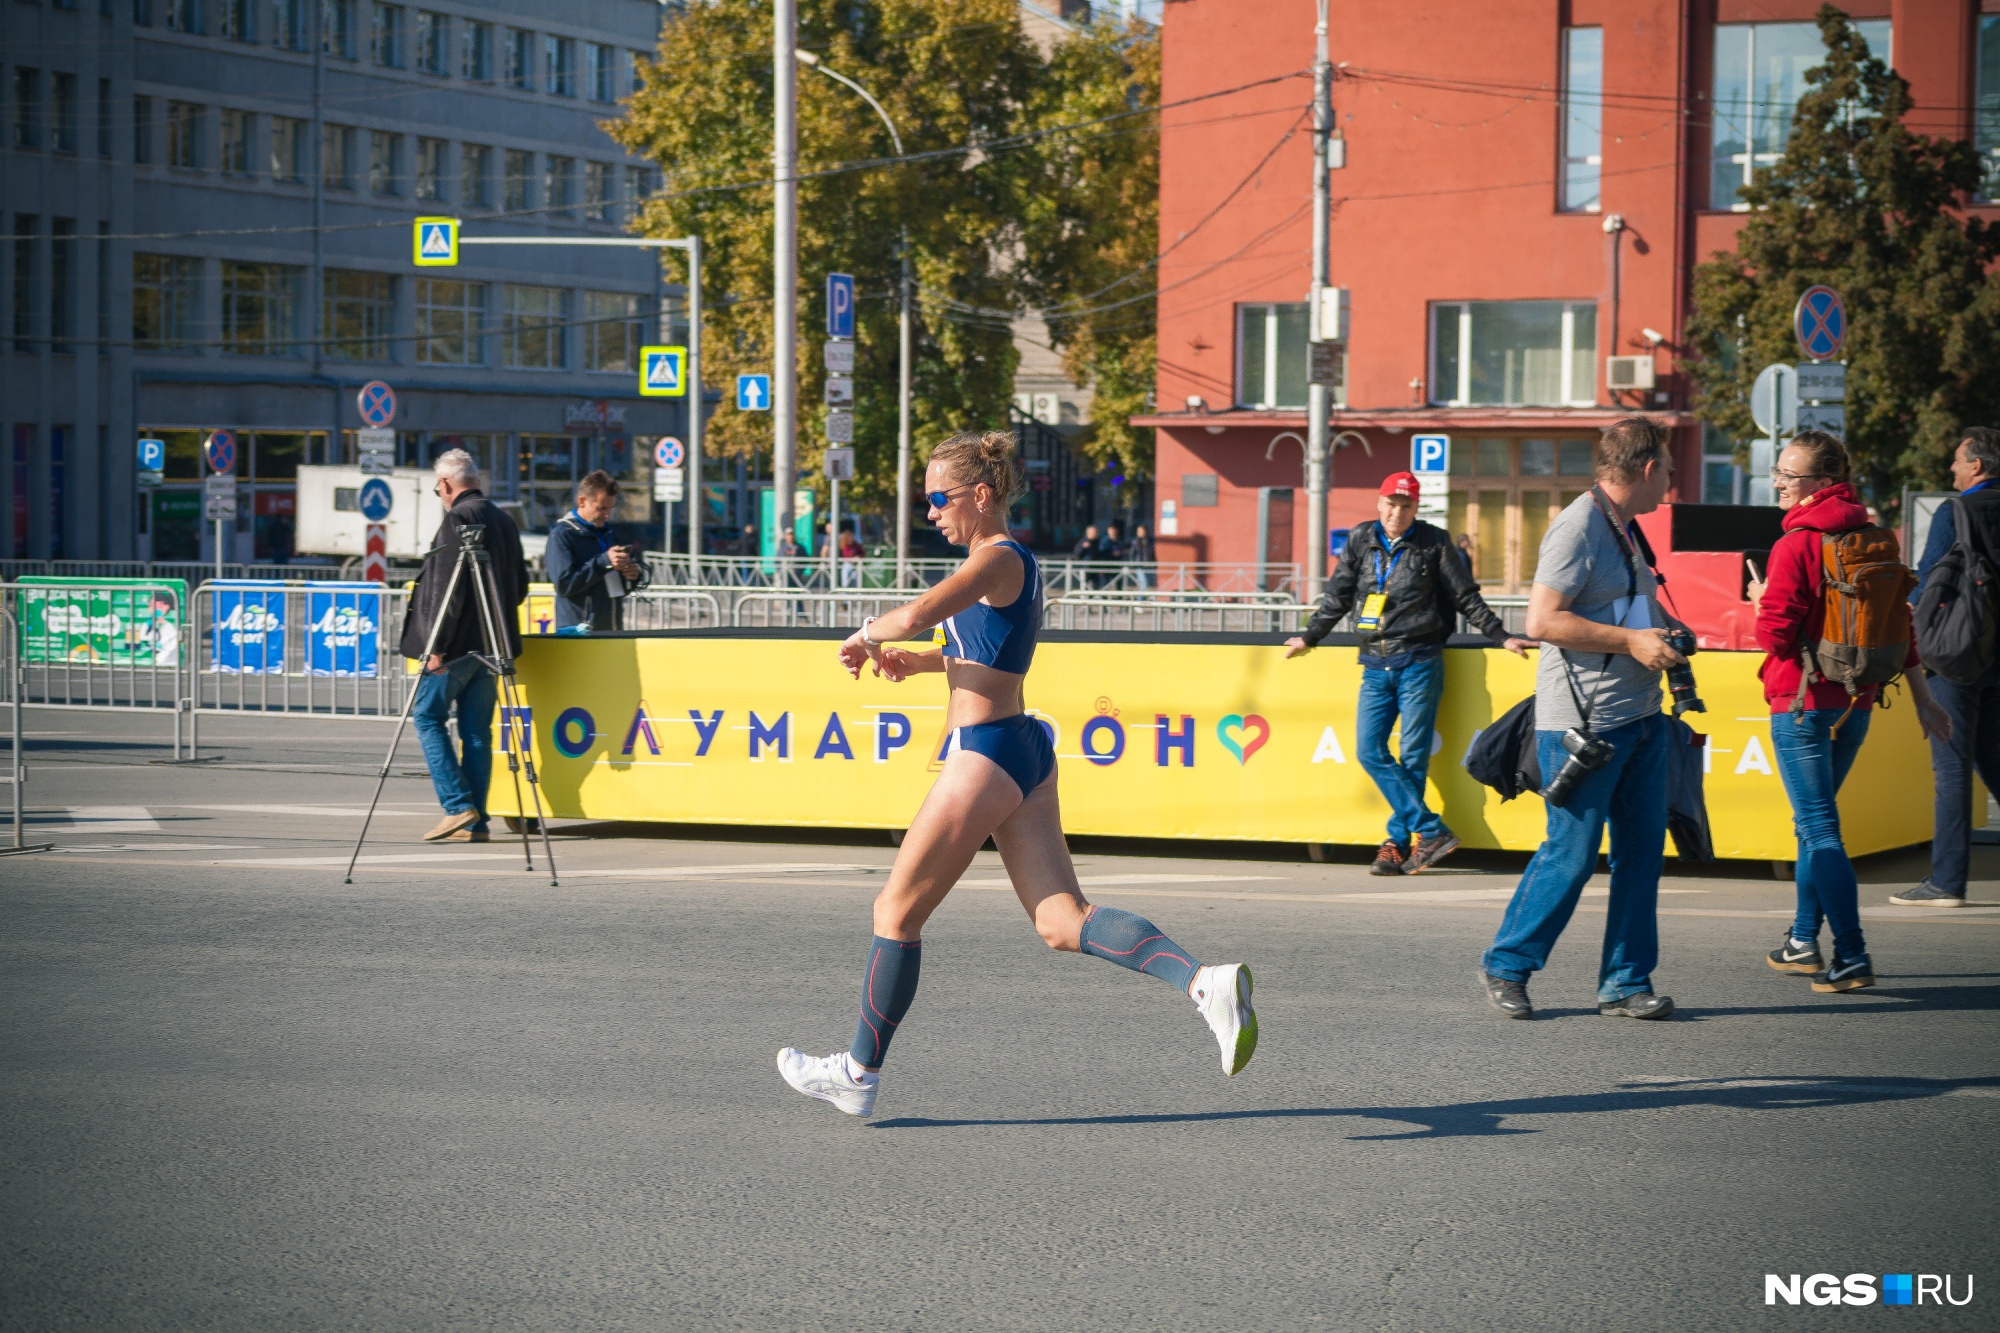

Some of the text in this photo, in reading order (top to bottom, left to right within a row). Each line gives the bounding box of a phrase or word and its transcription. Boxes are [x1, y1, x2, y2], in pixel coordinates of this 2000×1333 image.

[833, 282, 848, 332] P
[144, 443, 159, 465] P
[1420, 440, 1443, 470] P
